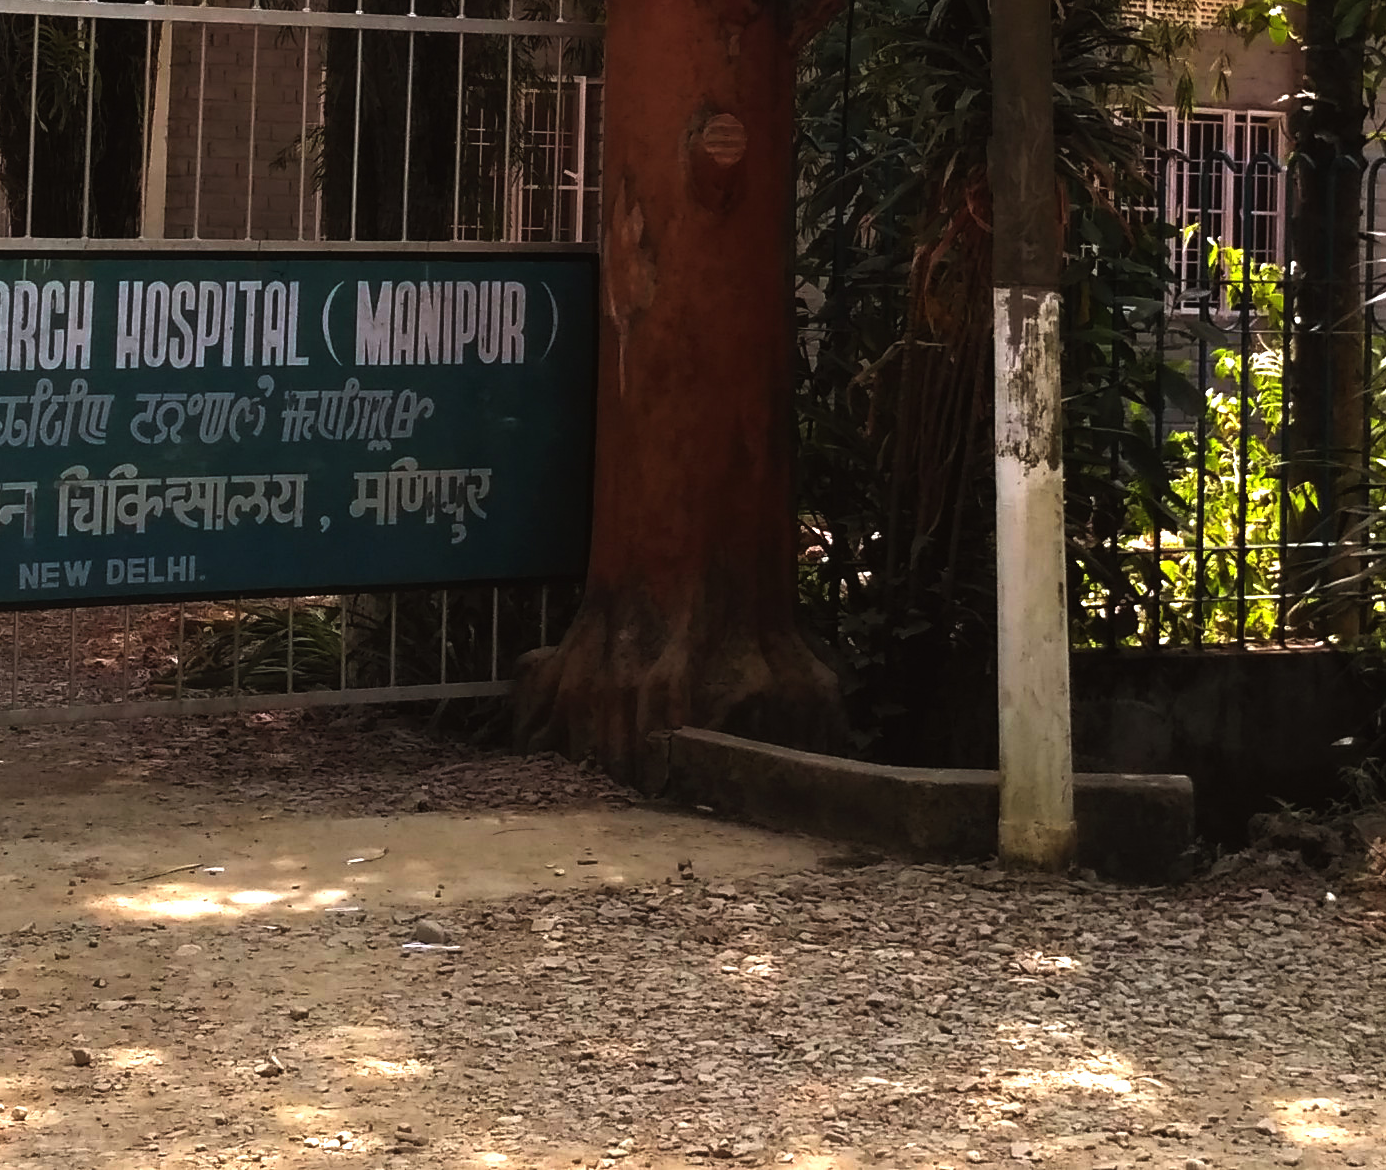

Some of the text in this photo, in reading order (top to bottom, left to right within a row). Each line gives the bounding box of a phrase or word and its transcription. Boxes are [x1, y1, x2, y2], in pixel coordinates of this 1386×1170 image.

[116, 280, 309, 369] HOSPITAL
[350, 457, 491, 543] मणिपुर
[20, 561, 91, 589] NEW
